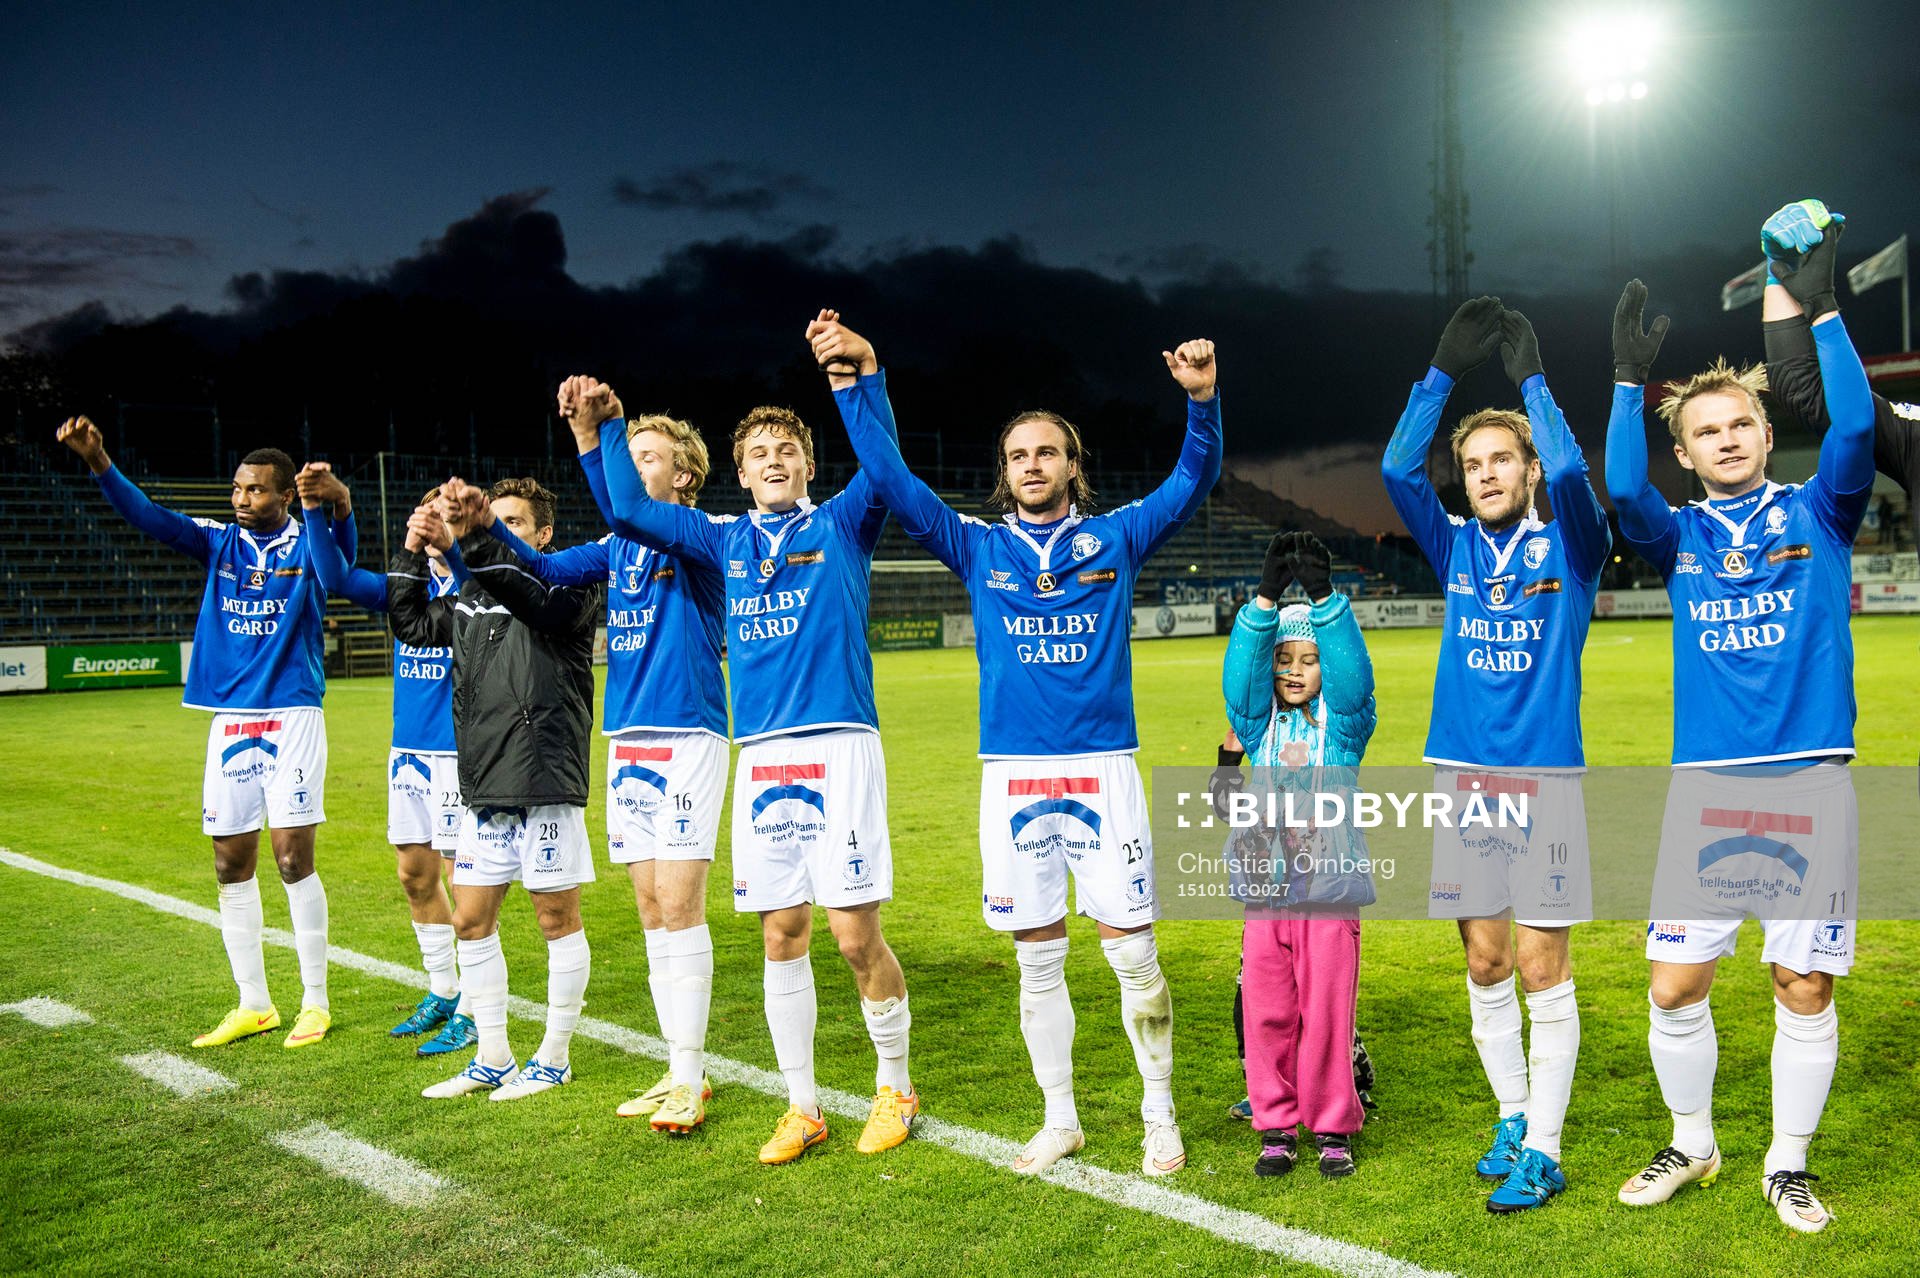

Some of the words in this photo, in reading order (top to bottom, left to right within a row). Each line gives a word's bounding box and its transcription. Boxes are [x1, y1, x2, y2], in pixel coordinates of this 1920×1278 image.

[1079, 572, 1108, 582] Swedbank
[221, 596, 289, 616] MELLBY
[730, 588, 810, 616] MELLBY
[1688, 589, 1796, 622] MELLBY
[739, 617, 799, 642] GÅRD
[1002, 613, 1099, 636] MELLBY
[1457, 616, 1545, 642] MELLBY
[1700, 623, 1786, 652] GÅRD
[1017, 639, 1087, 664] GÅRD
[1467, 645, 1532, 672] GÅRD
[72, 657, 160, 675] Europcar
[399, 659, 446, 680] GÅRD
[294, 768, 304, 784] 3
[441, 791, 459, 807] 22
[673, 792, 692, 811] 16
[539, 822, 559, 840] 28
[847, 830, 858, 850] 4
[1122, 838, 1143, 865] 25
[1548, 842, 1568, 865] 10
[1431, 891, 1462, 901] SPORT
[1698, 876, 1760, 889] Trelleborgs
[1785, 883, 1802, 897] AB
[1738, 889, 1747, 897] of
[989, 905, 1014, 914] SPORT
[1829, 889, 1846, 915] 11
[1656, 923, 1686, 934] INTER
[1656, 933, 1687, 944] SPORT
